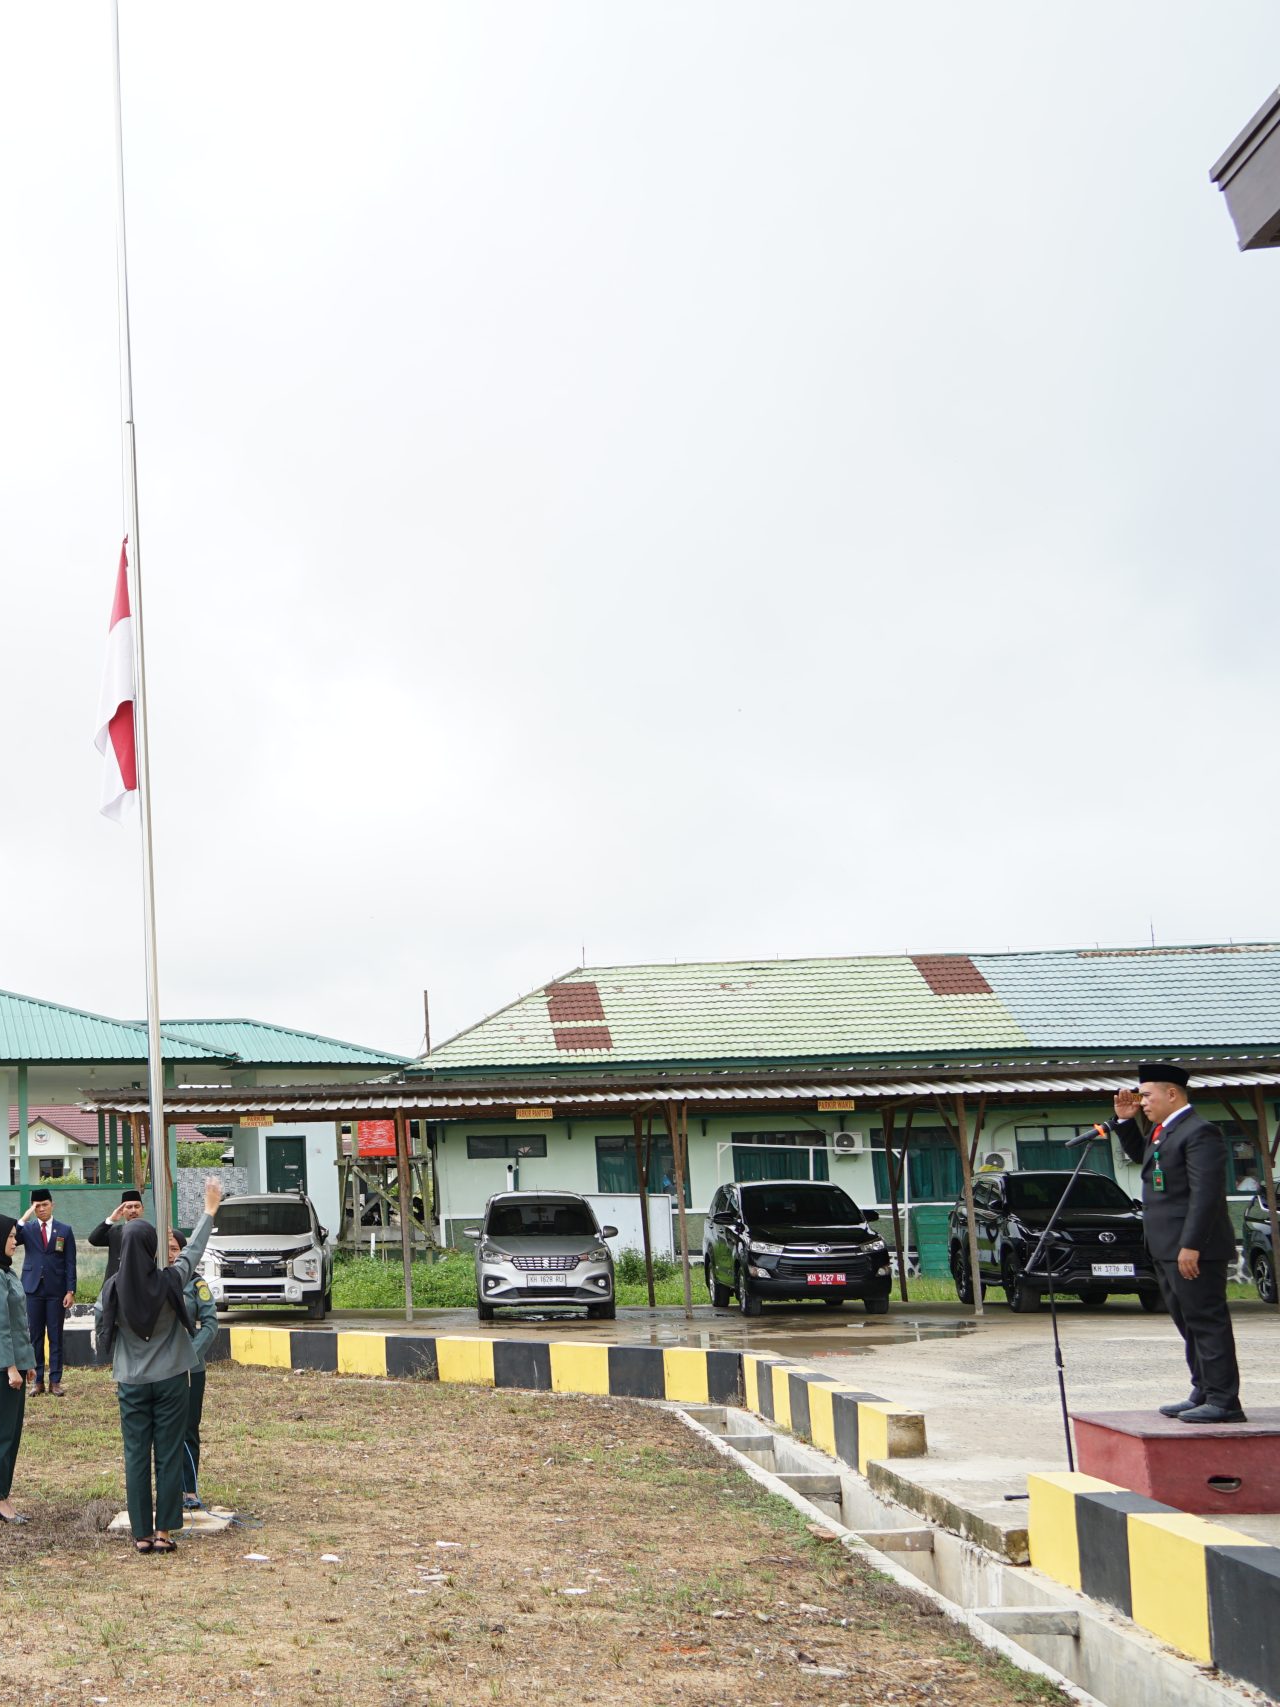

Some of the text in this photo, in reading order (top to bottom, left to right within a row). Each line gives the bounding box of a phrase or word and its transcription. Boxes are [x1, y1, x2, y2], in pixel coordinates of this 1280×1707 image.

[818, 1101, 853, 1110] PARKIR WAKIL
[517, 1109, 552, 1118] PARKIR PANITERA
[1093, 1265, 1133, 1273] KH 1776 RU
[807, 1274, 846, 1282] KH 1627 RU
